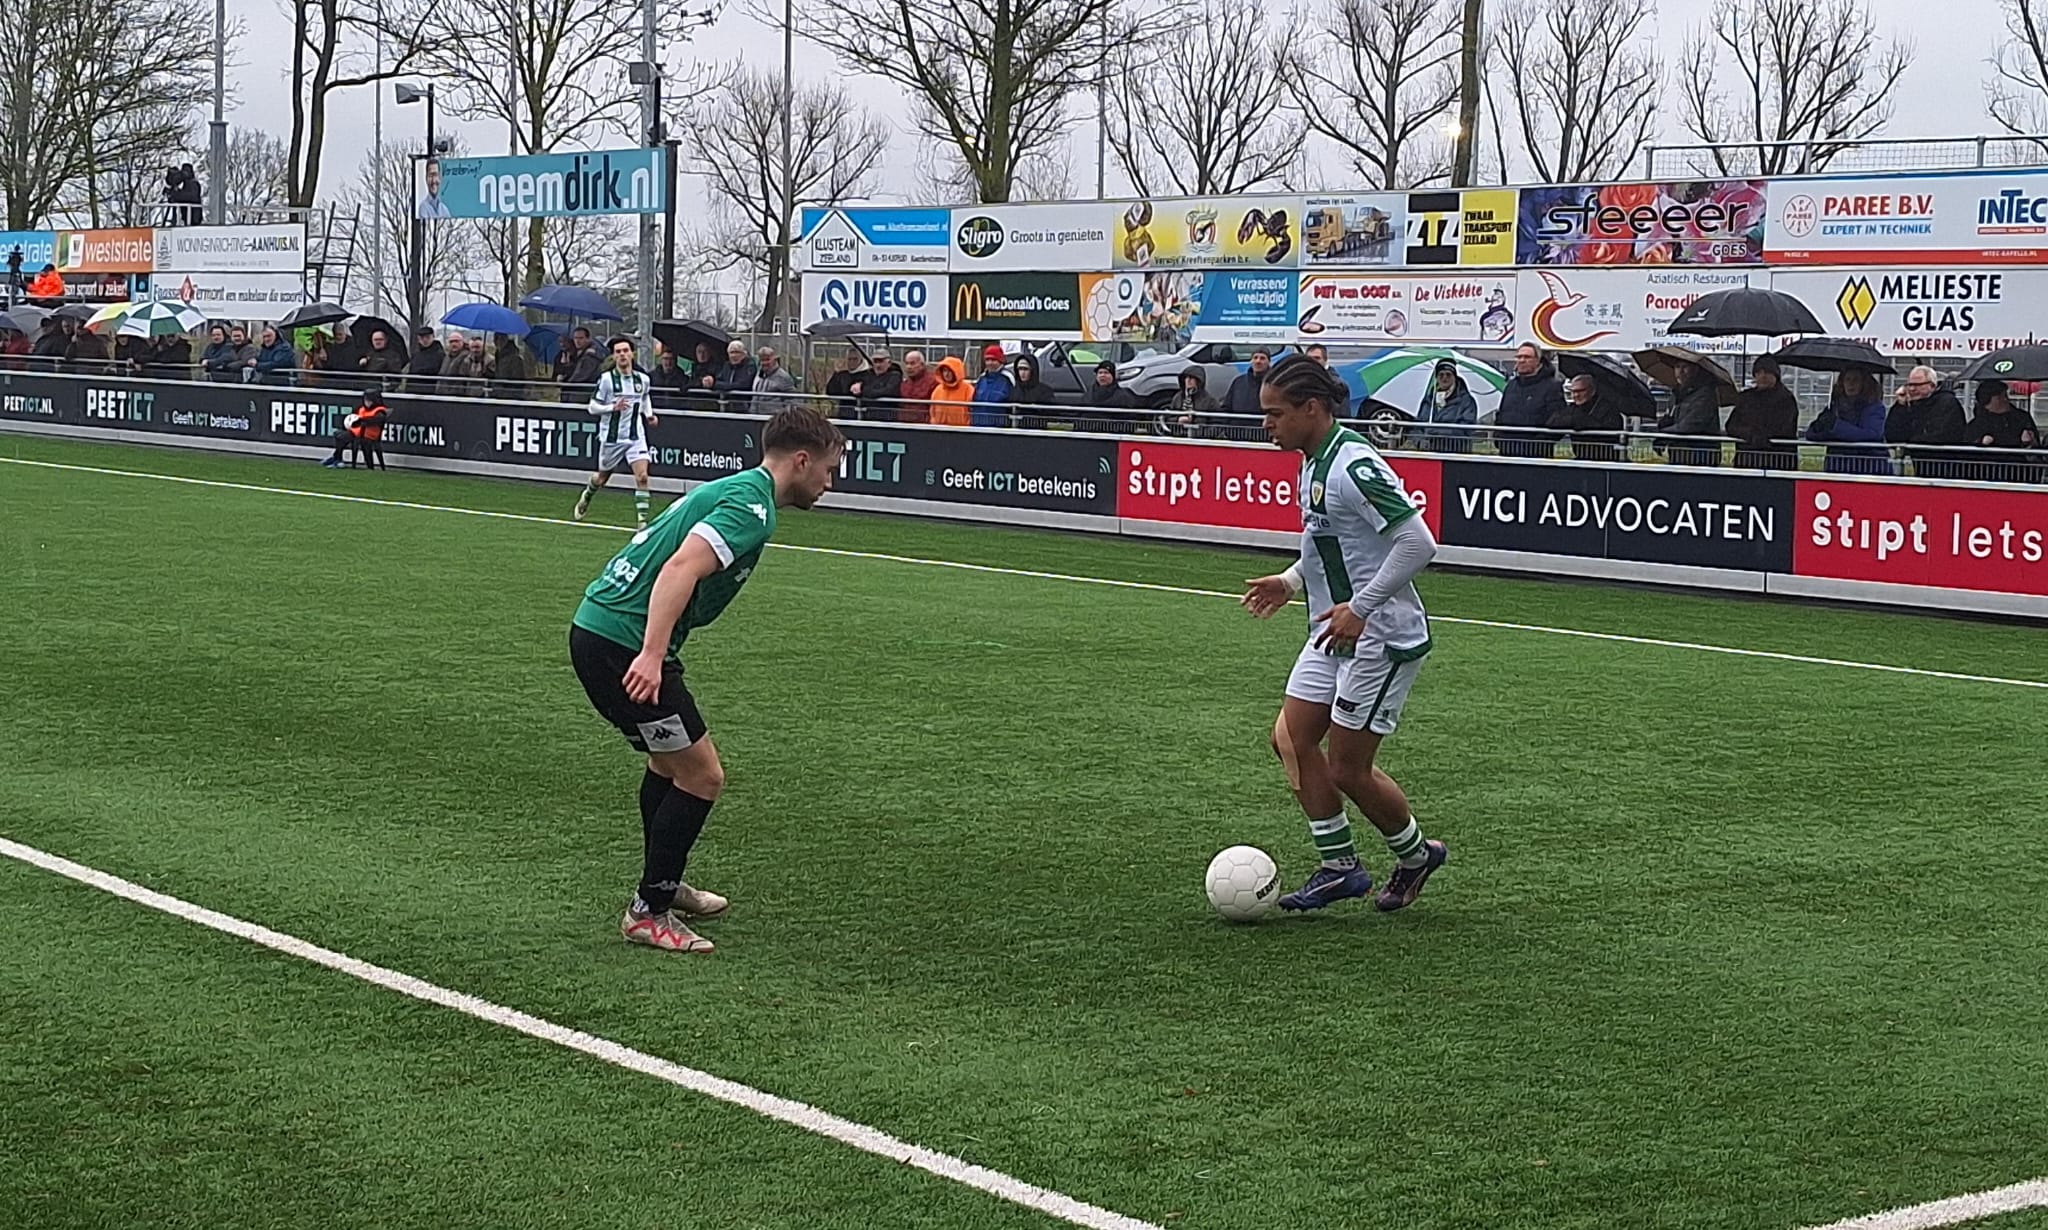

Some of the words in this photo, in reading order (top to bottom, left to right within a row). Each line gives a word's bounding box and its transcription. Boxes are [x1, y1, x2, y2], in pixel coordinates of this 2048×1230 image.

[479, 151, 658, 213] neemdirk.nl
[1824, 196, 1890, 216] PAREE
[1898, 195, 1933, 215] B.V.
[1978, 190, 2048, 224] INTEC
[959, 221, 1003, 249] Sligro
[1011, 230, 1043, 244] Groots
[1046, 231, 1056, 243] in
[1058, 229, 1104, 246] genieten
[1464, 222, 1512, 233] TRANSPORT
[1822, 225, 1861, 236] EXPERT
[1865, 225, 1879, 235] IN
[1881, 224, 1931, 235] TECHNIEK
[85, 237, 152, 263] weststrate
[815, 238, 856, 252] KLUSTEAM
[1464, 235, 1497, 245] ZEELAND
[1712, 243, 1747, 256] GOES
[820, 253, 850, 264] ZEELAND
[1230, 276, 1288, 290] Verrassend
[1647, 273, 1690, 284] Aziatisch
[1693, 273, 1747, 284] Restaurant
[1880, 274, 2002, 300] MELIESTE
[853, 280, 927, 308] IVECO
[1238, 290, 1288, 308] veelzijdig!
[1314, 285, 1336, 298] PIET
[1339, 288, 1358, 298] van
[1360, 285, 1391, 298] OOST
[1415, 286, 1430, 302] De
[1646, 293, 1699, 310] Paradi
[985, 296, 1043, 311] McDonald's
[1044, 297, 1070, 311] Goes
[1902, 306, 1975, 332] GLAS
[1892, 338, 1952, 351] MODERN
[4, 395, 54, 414] PEETICT.NL
[87, 388, 155, 422] PEETICT
[172, 410, 194, 426] Geeft
[195, 412, 209, 427] ICT
[210, 414, 250, 432] betekenis
[381, 423, 446, 447] EETICT.NL
[496, 416, 597, 458] PEETICT
[661, 448, 681, 466] ICT
[683, 449, 743, 471] betekenis
[838, 439, 906, 483] TICT
[942, 468, 984, 491] Geeft
[988, 471, 1015, 492] ICT
[1018, 473, 1096, 500] betekenis
[1458, 487, 1526, 524] VICI
[1538, 492, 1775, 542] ADVOCATEN
[1952, 512, 2044, 562] lets
